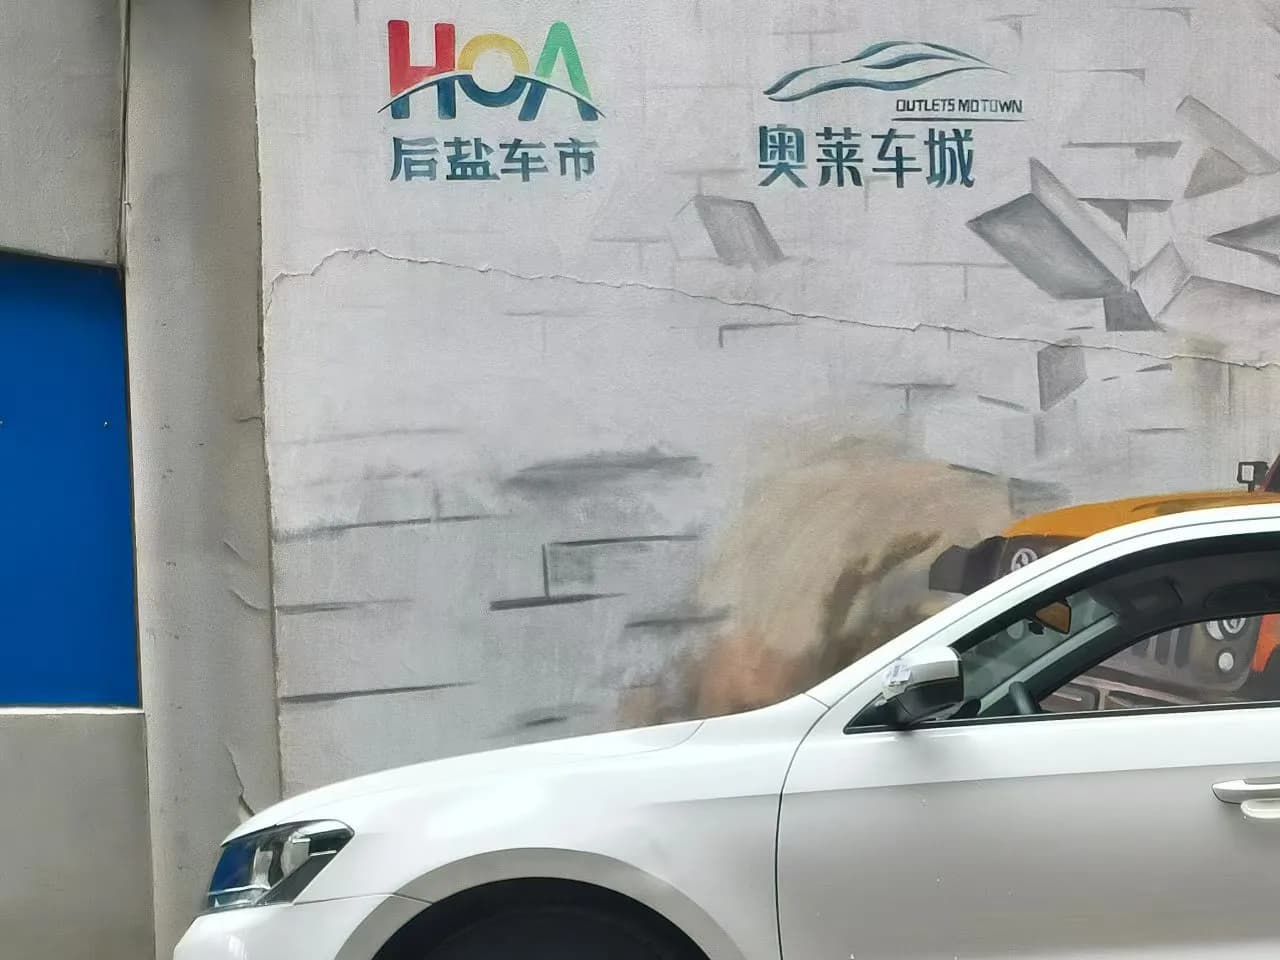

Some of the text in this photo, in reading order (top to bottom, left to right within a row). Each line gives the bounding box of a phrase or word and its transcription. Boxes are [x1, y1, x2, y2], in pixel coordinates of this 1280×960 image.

[388, 19, 599, 122] HOA
[896, 98, 1023, 114] OUTLETS MOTOWN
[390, 136, 599, 183] 后盐车市
[757, 123, 976, 189] 奥莱车城
